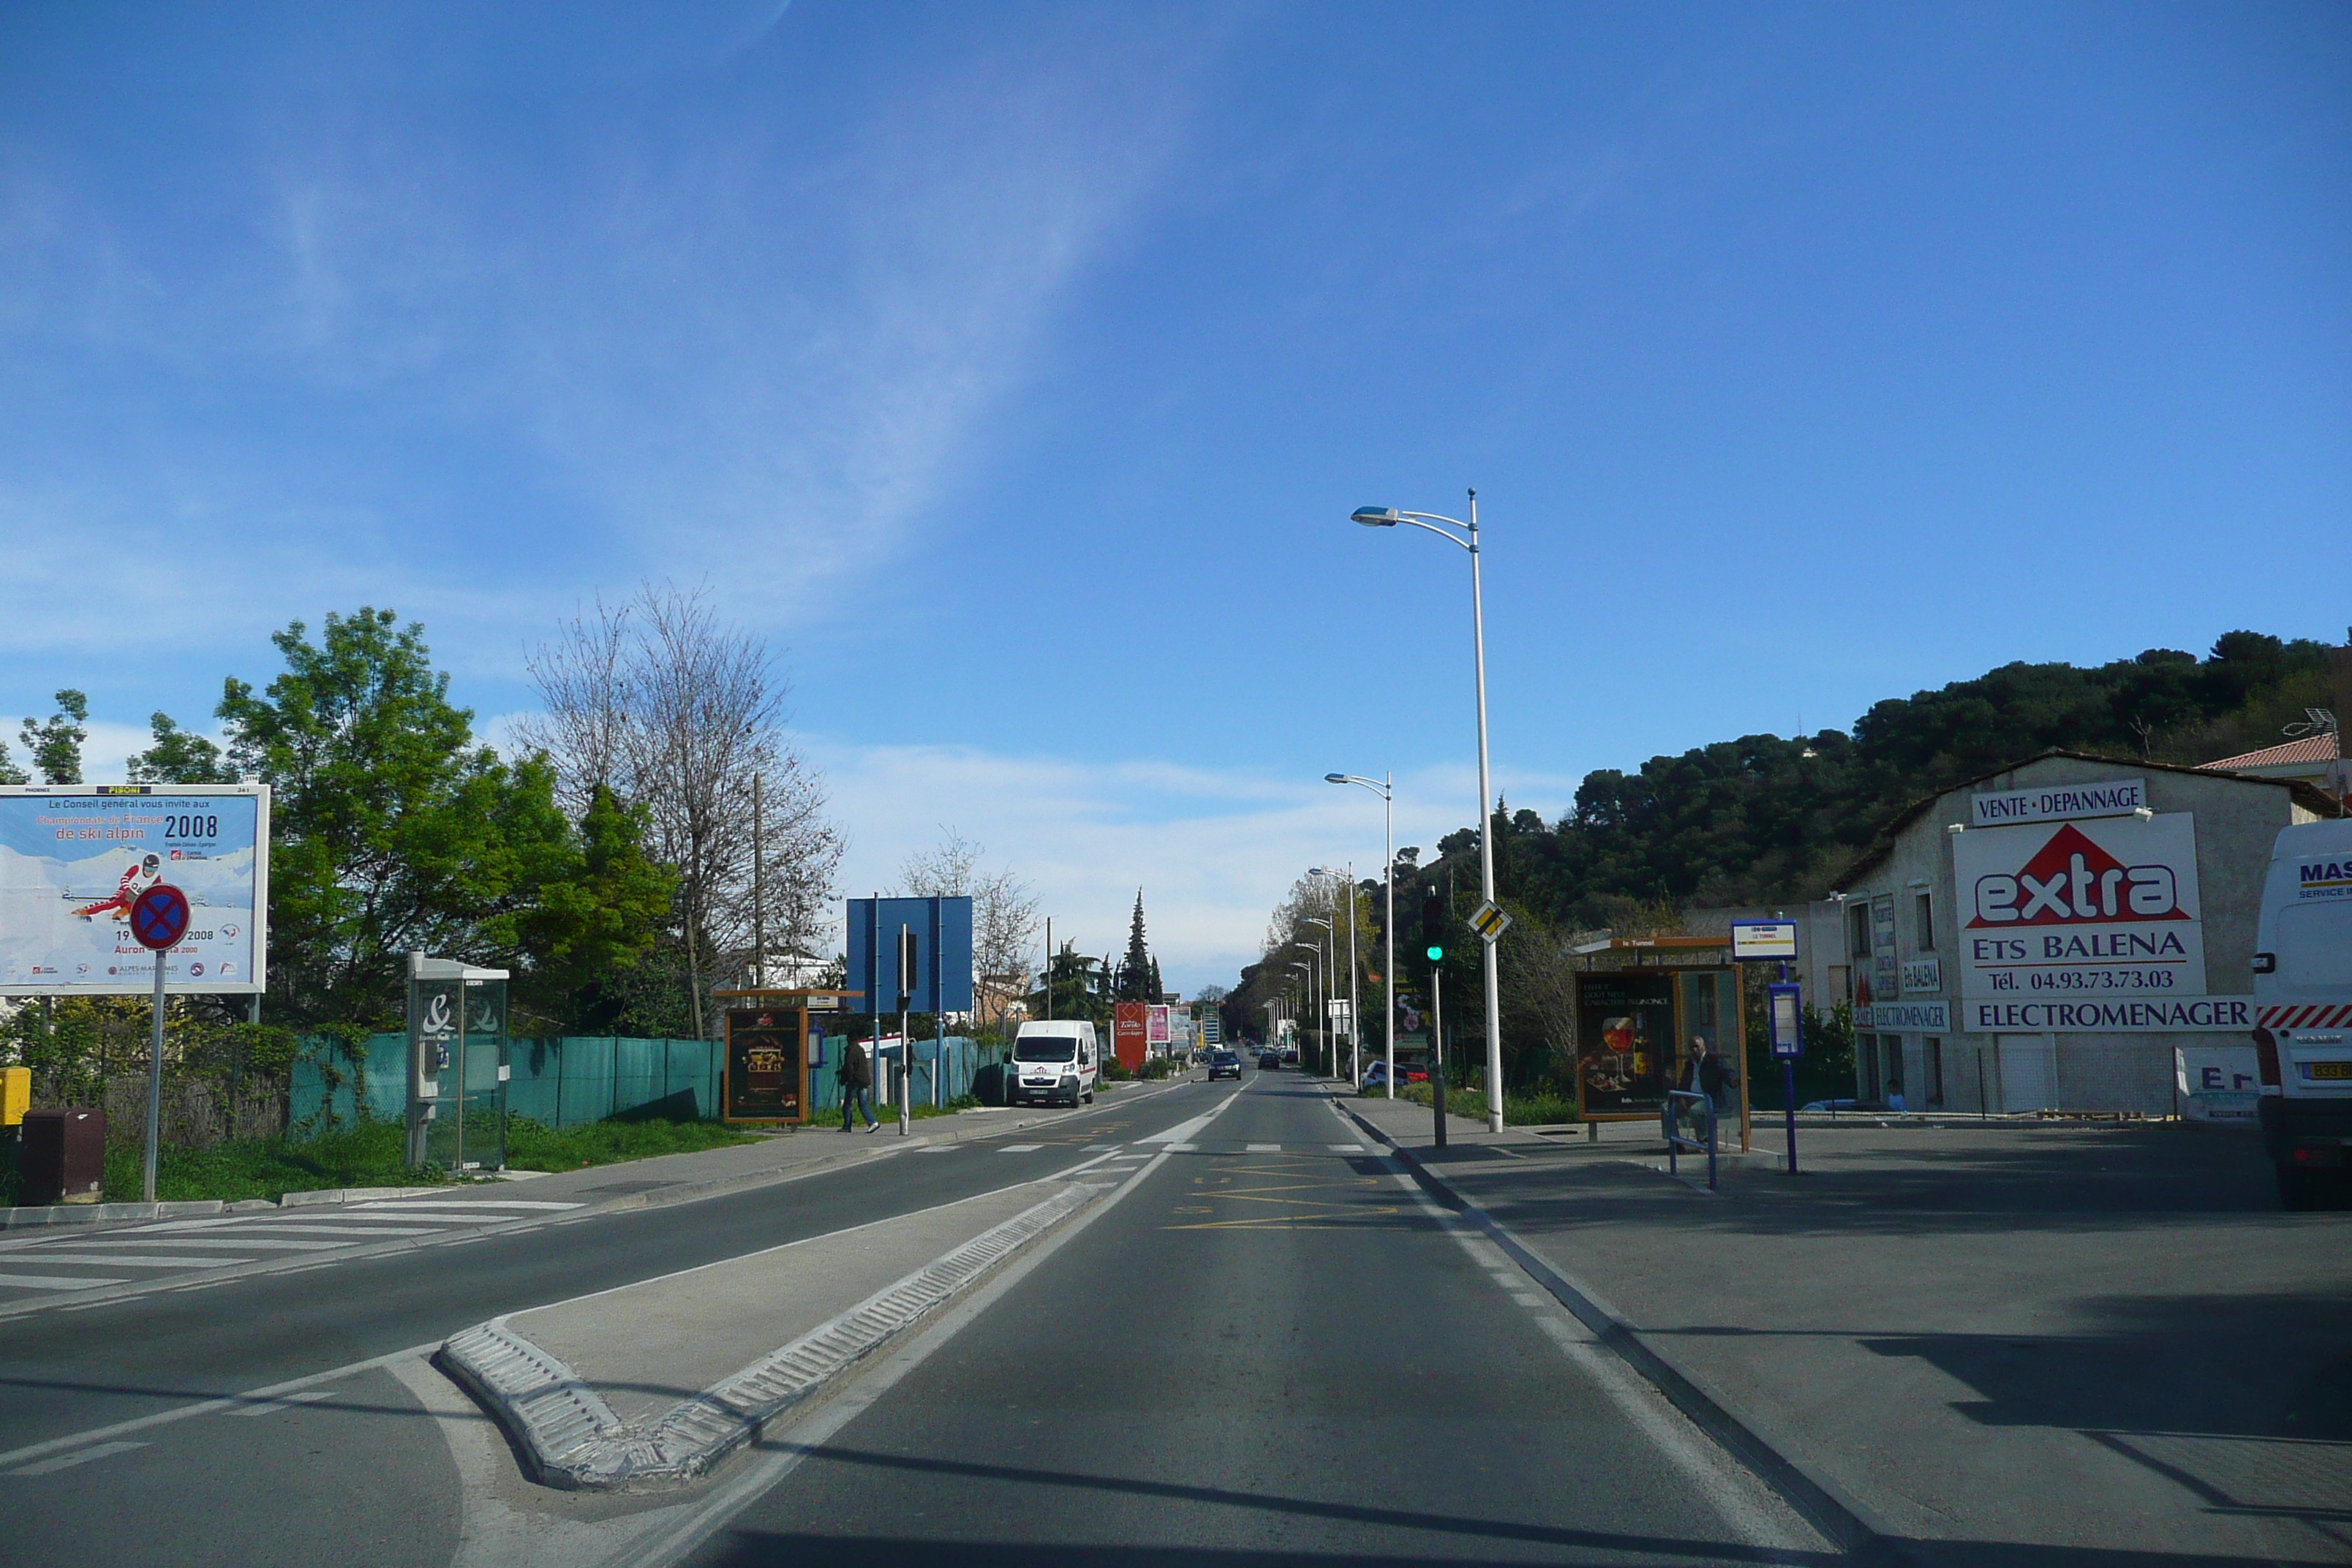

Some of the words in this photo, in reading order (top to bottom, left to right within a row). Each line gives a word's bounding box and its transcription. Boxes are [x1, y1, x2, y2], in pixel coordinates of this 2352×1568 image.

[49, 800, 61, 808] Le
[64, 799, 99, 809] Conseil
[102, 799, 138, 810] général
[165, 799, 192, 808] invite
[1978, 796, 2027, 818] VENTE
[2040, 787, 2139, 814] DEPANNAGE
[37, 815, 107, 826] Championnats
[108, 816, 121, 824] de
[123, 813, 163, 824] France
[165, 815, 218, 838] 2008
[56, 827, 75, 840] de
[79, 827, 102, 840] ski
[105, 826, 145, 842] alpin
[1974, 851, 2178, 924] extra
[2299, 887, 2345, 899] SERVICE
[116, 930, 129, 941] 19
[187, 930, 214, 941] 2008
[1972, 938, 2027, 960] ETS
[2043, 930, 2187, 960] BALENA
[114, 945, 146, 954] Auron
[1913, 963, 1938, 987] BALENA
[1989, 972, 2020, 990] Tél.
[2030, 970, 2174, 990] 04.93.73.73.03
[1876, 1006, 1945, 1028] ELECTROMENAGER
[1978, 1001, 2250, 1027] ELECTROMENAGER
